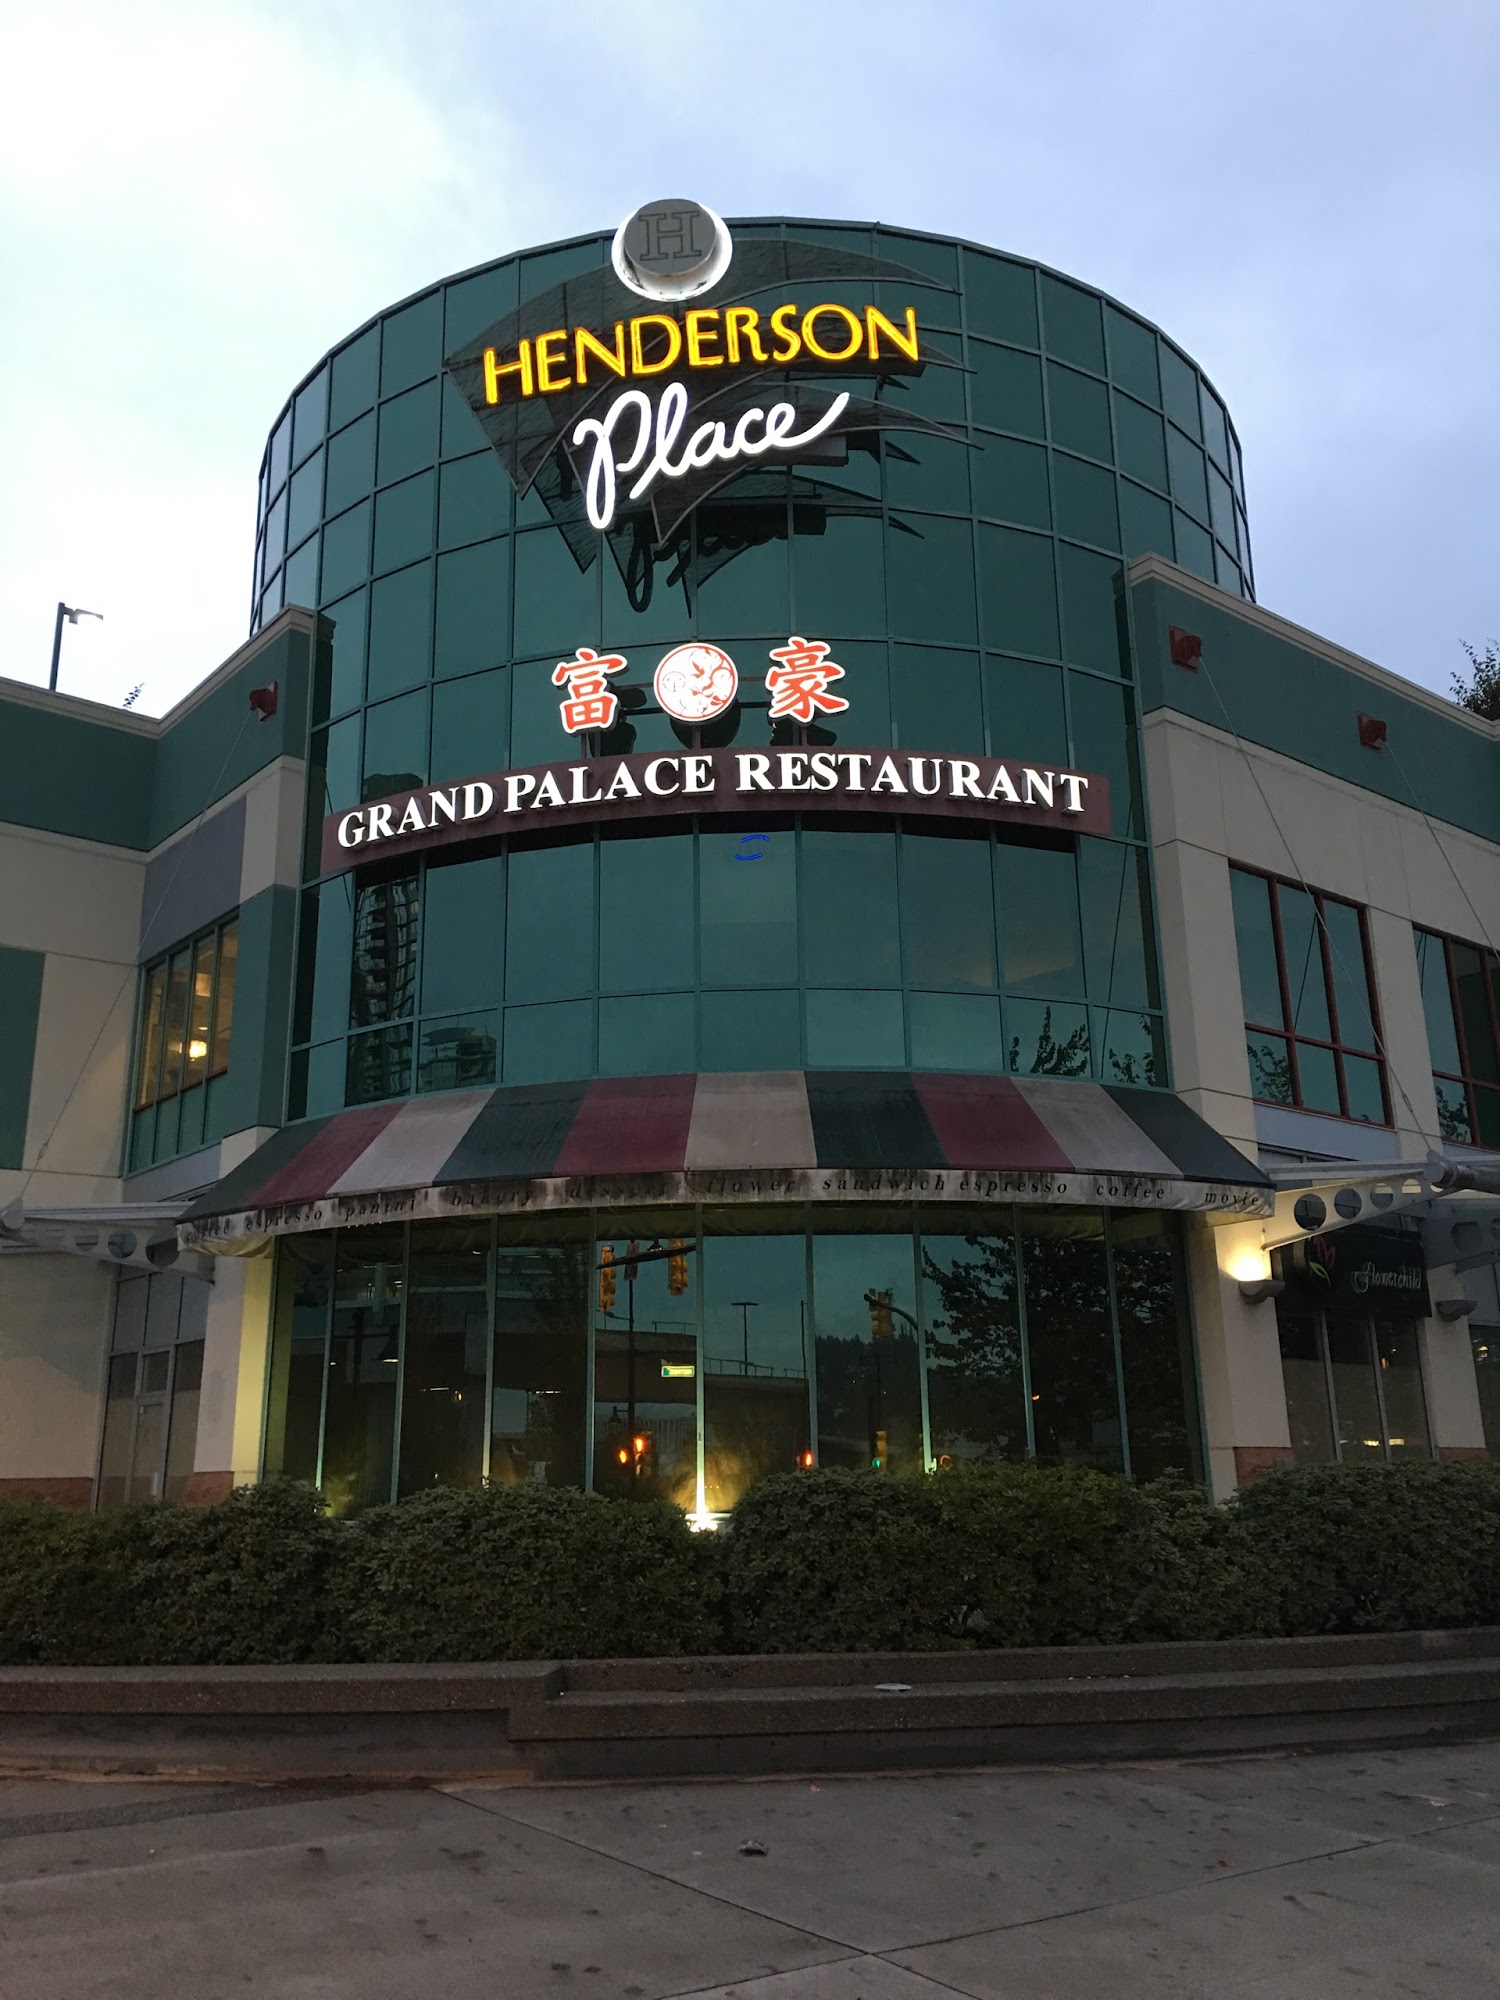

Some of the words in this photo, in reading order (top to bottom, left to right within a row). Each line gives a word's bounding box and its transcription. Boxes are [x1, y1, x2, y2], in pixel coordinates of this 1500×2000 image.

[637, 210, 703, 262] H
[483, 303, 920, 404] HENDERSON
[572, 381, 850, 530] Place
[551, 647, 628, 734] 富
[765, 636, 850, 724] 豪
[337, 781, 494, 849] GRAND
[503, 754, 716, 813] PALACE
[734, 752, 1089, 813] RESTAURANT
[705, 1176, 798, 1195] flower
[822, 1173, 946, 1191] sandwich
[959, 1178, 1068, 1197] espresso
[1096, 1182, 1165, 1200] coffee
[1205, 1190, 1260, 1206] movie
